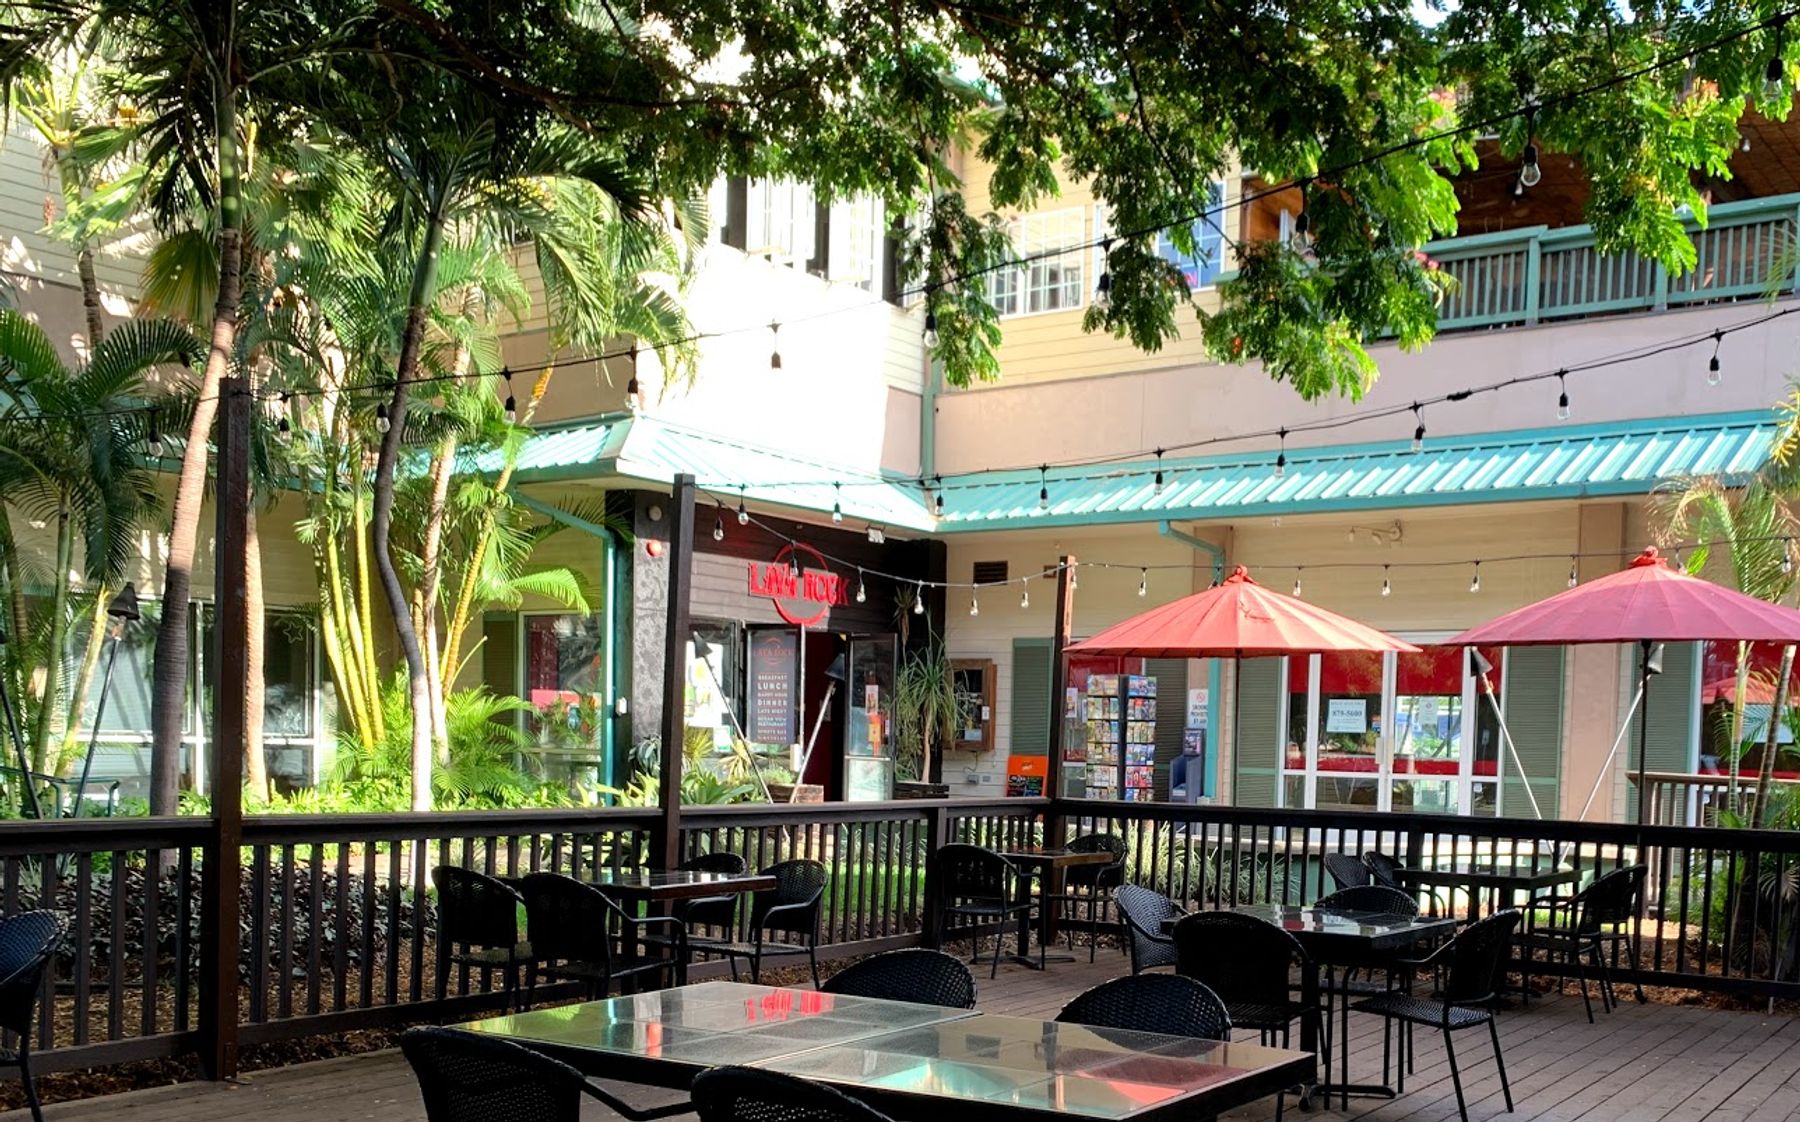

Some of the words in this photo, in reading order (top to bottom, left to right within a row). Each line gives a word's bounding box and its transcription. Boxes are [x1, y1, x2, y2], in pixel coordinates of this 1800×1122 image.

[750, 562, 798, 599] LAVA
[803, 571, 849, 606] ROCK
[757, 682, 788, 690] LUNCH
